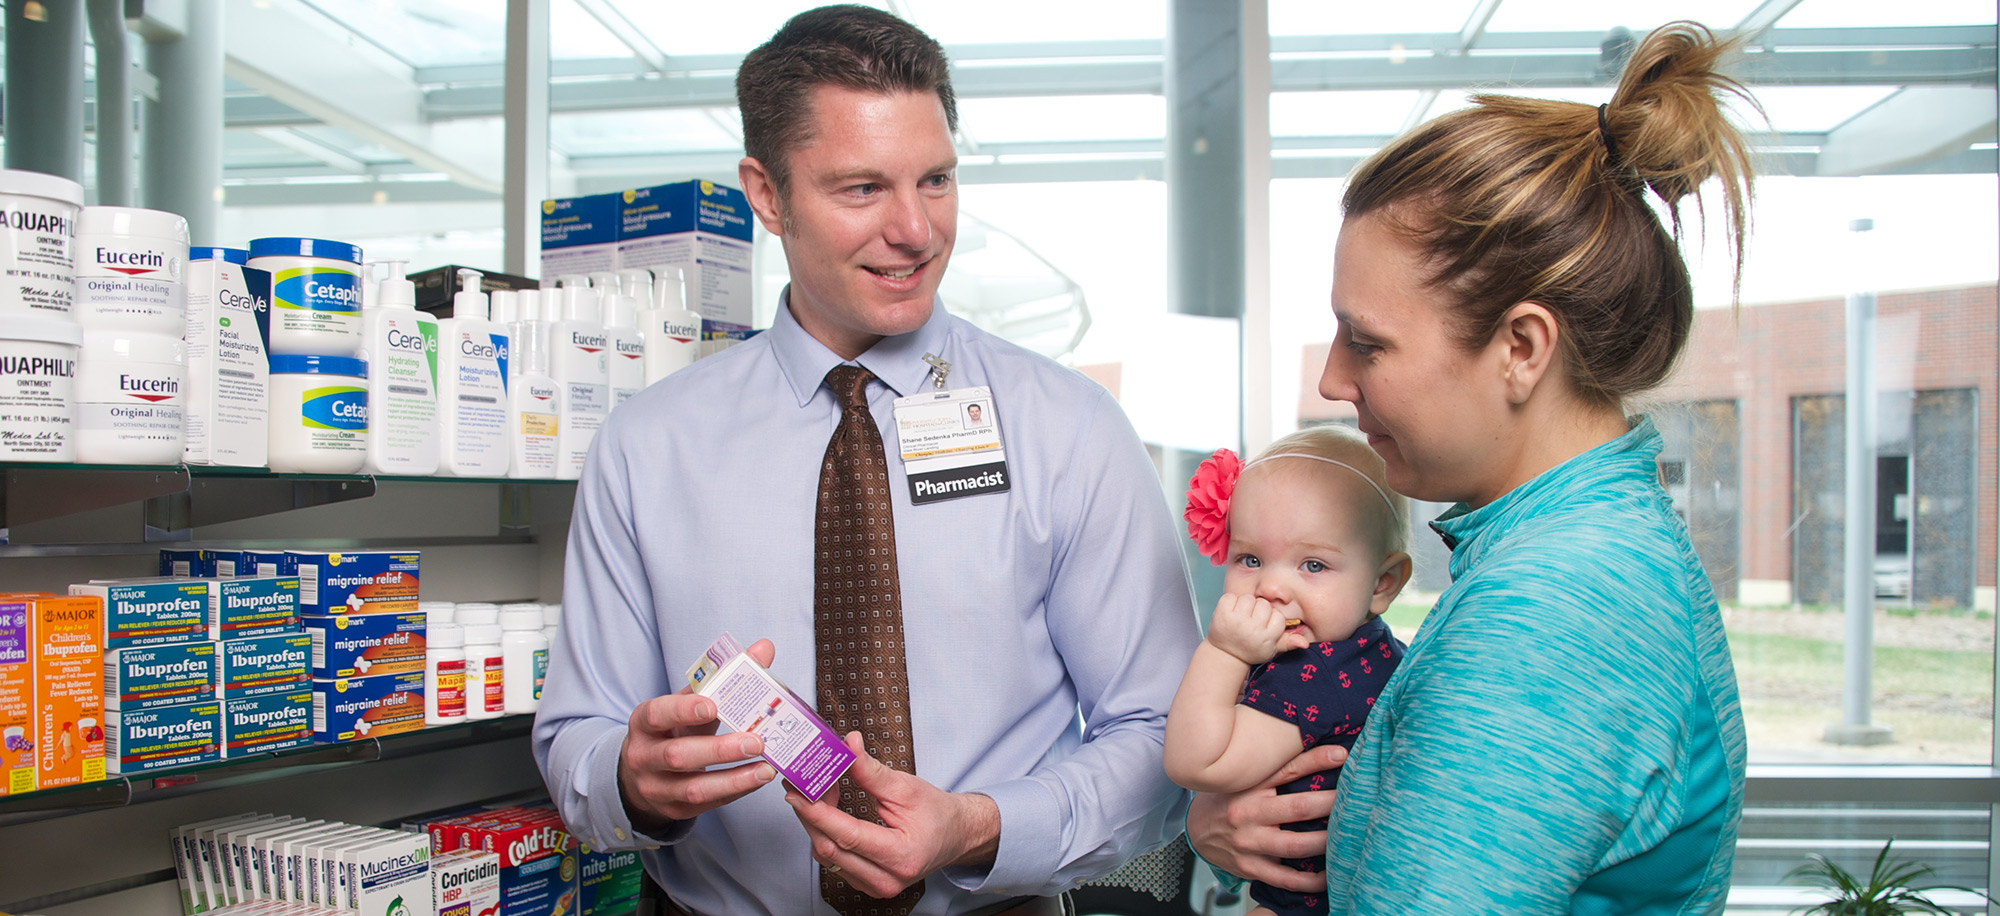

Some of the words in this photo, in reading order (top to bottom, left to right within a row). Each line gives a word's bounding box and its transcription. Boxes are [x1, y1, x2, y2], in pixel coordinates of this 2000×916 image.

[0, 209, 76, 239] AQUAPHIL
[96, 247, 162, 267] Eucerin
[88, 281, 131, 292] Original
[136, 282, 170, 296] Healing
[219, 289, 267, 313] CeraVe
[312, 312, 332, 320] Cream
[219, 329, 239, 340] Facial
[664, 320, 697, 337] Eucerin
[219, 340, 259, 354] Moisturizing
[388, 329, 437, 352] CeraVe
[572, 331, 606, 347] Eucerin
[219, 349, 240, 359] Lotion
[461, 340, 508, 360] CeraVe
[388, 356, 419, 368] Hydrating
[388, 366, 417, 376] Cleanser
[459, 365, 498, 378] Moisturizing
[459, 374, 480, 382] Lotion
[17, 379, 52, 387] OINTMENT
[120, 374, 178, 393] Eucerin
[110, 407, 153, 419] Original
[332, 400, 368, 423] Cetap
[915, 471, 1004, 497] Pharmacist
[327, 573, 374, 589] migraine
[376, 571, 402, 584] relief
[120, 590, 146, 600] MAJOR
[230, 586, 251, 594] MAJOR
[117, 598, 200, 616] Ibuprofen
[227, 592, 293, 610] Ibuprofen
[57, 609, 95, 622] MAJOR
[180, 611, 201, 619] 200mg
[50, 632, 92, 643] Children's
[335, 636, 381, 652] migraine
[384, 631, 409, 646] relief
[43, 641, 97, 658] Ibuprofen
[131, 652, 156, 662] MAJOR
[232, 650, 305, 667] Ibuprofen
[128, 659, 207, 678] Ibuprofen
[52, 682, 66, 690] Pain
[152, 698, 174, 706] COATED
[335, 698, 380, 714] migraine
[383, 691, 408, 706] relief
[132, 714, 158, 724] MAJOR
[234, 706, 306, 726] Ibuprofen
[130, 719, 211, 739] Ibuprofen
[43, 704, 54, 772] Children's
[154, 759, 176, 767] COATED
[508, 826, 571, 867] Cold-EEZE
[582, 858, 607, 877] nite
[608, 852, 635, 870] time
[442, 862, 498, 889] Coricidin
[443, 887, 462, 904] HBP
